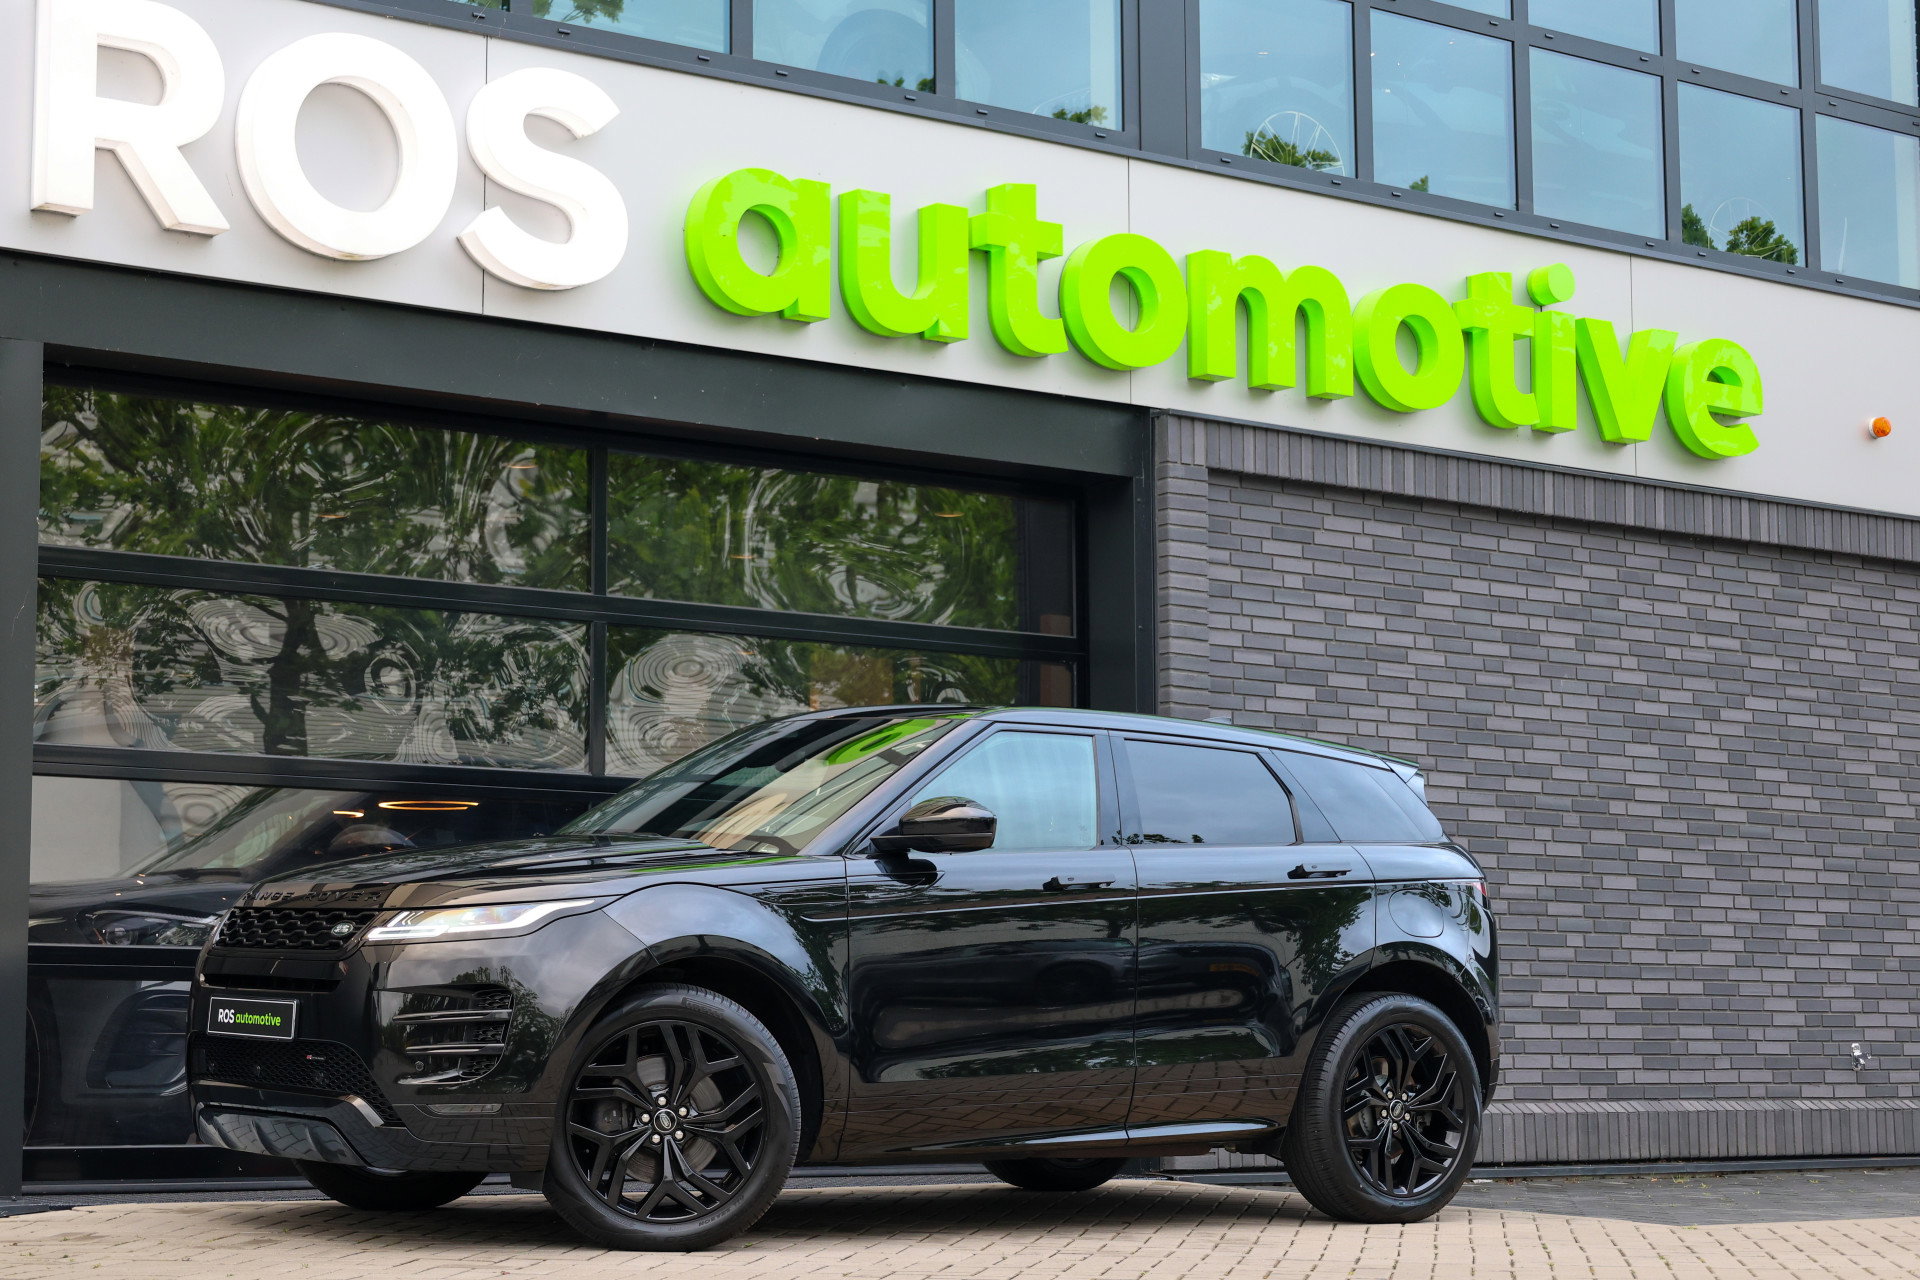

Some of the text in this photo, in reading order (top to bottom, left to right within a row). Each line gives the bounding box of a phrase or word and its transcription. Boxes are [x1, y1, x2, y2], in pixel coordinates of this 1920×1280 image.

[30, 0, 1763, 461] ROS automotive
[304, 890, 382, 902] ROVER
[218, 1009, 281, 1026] ROS automotive
